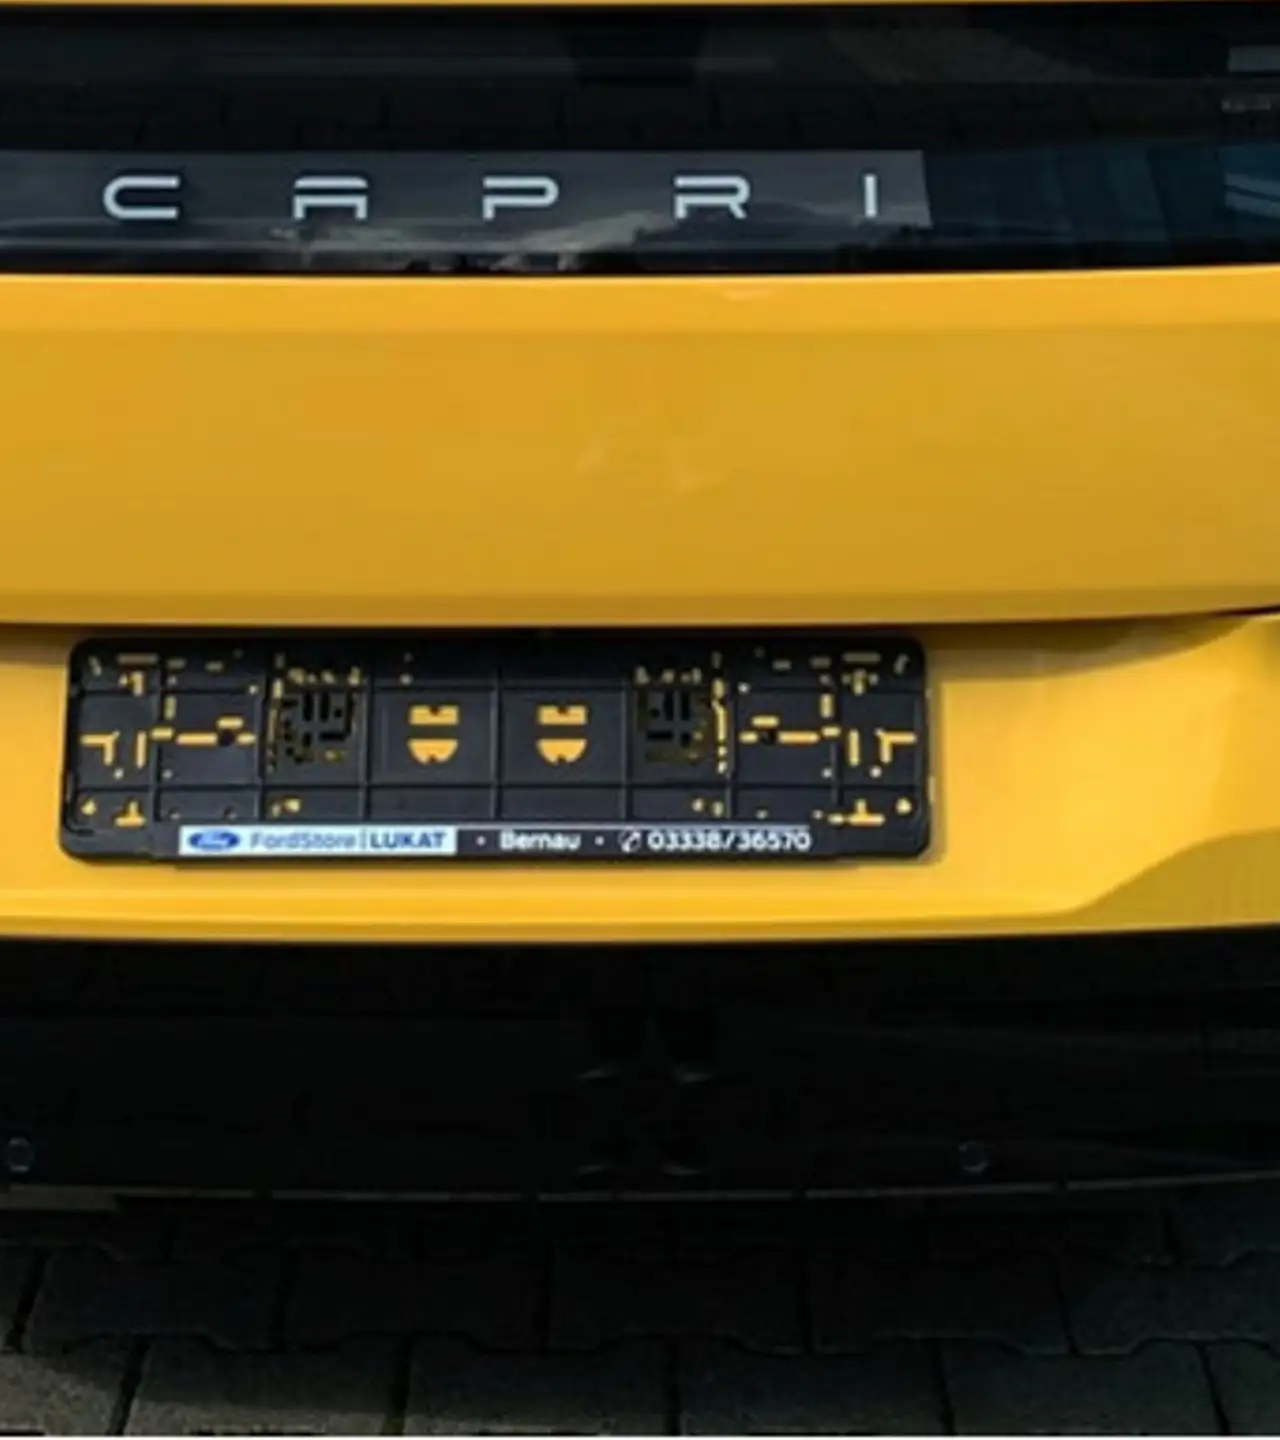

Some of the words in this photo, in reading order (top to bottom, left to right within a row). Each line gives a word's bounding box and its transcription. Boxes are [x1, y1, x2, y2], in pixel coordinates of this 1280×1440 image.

[102, 174, 878, 220] CAPRI
[249, 830, 356, 849] FordStore
[369, 830, 448, 849] LUKAT
[499, 830, 581, 850] Bernau
[647, 829, 812, 851] 03338/36570
